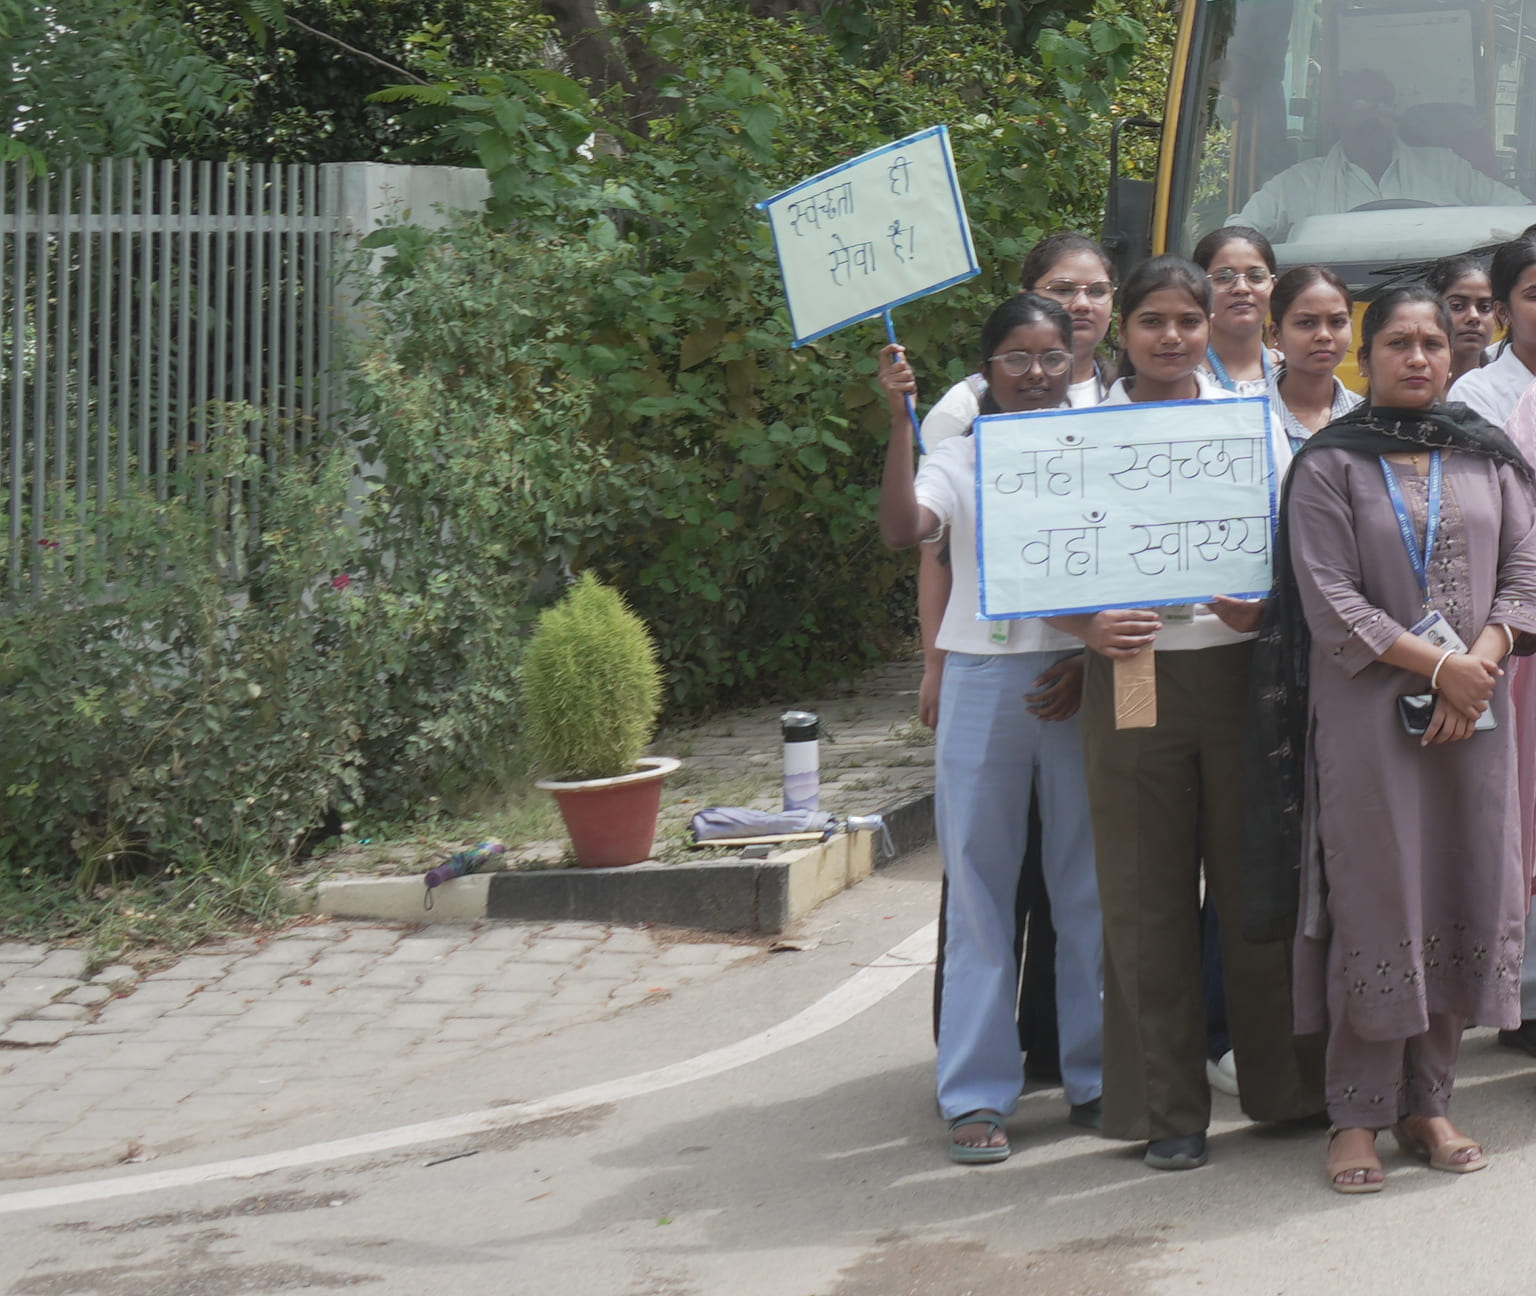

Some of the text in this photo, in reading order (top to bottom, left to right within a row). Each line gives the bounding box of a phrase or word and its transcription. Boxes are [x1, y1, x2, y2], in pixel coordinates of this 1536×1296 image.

[888, 156, 913, 196] ही
[828, 233, 876, 286] सेवा
[995, 434, 1098, 499] जहाँ
[1021, 511, 1106, 577] वहाँ
